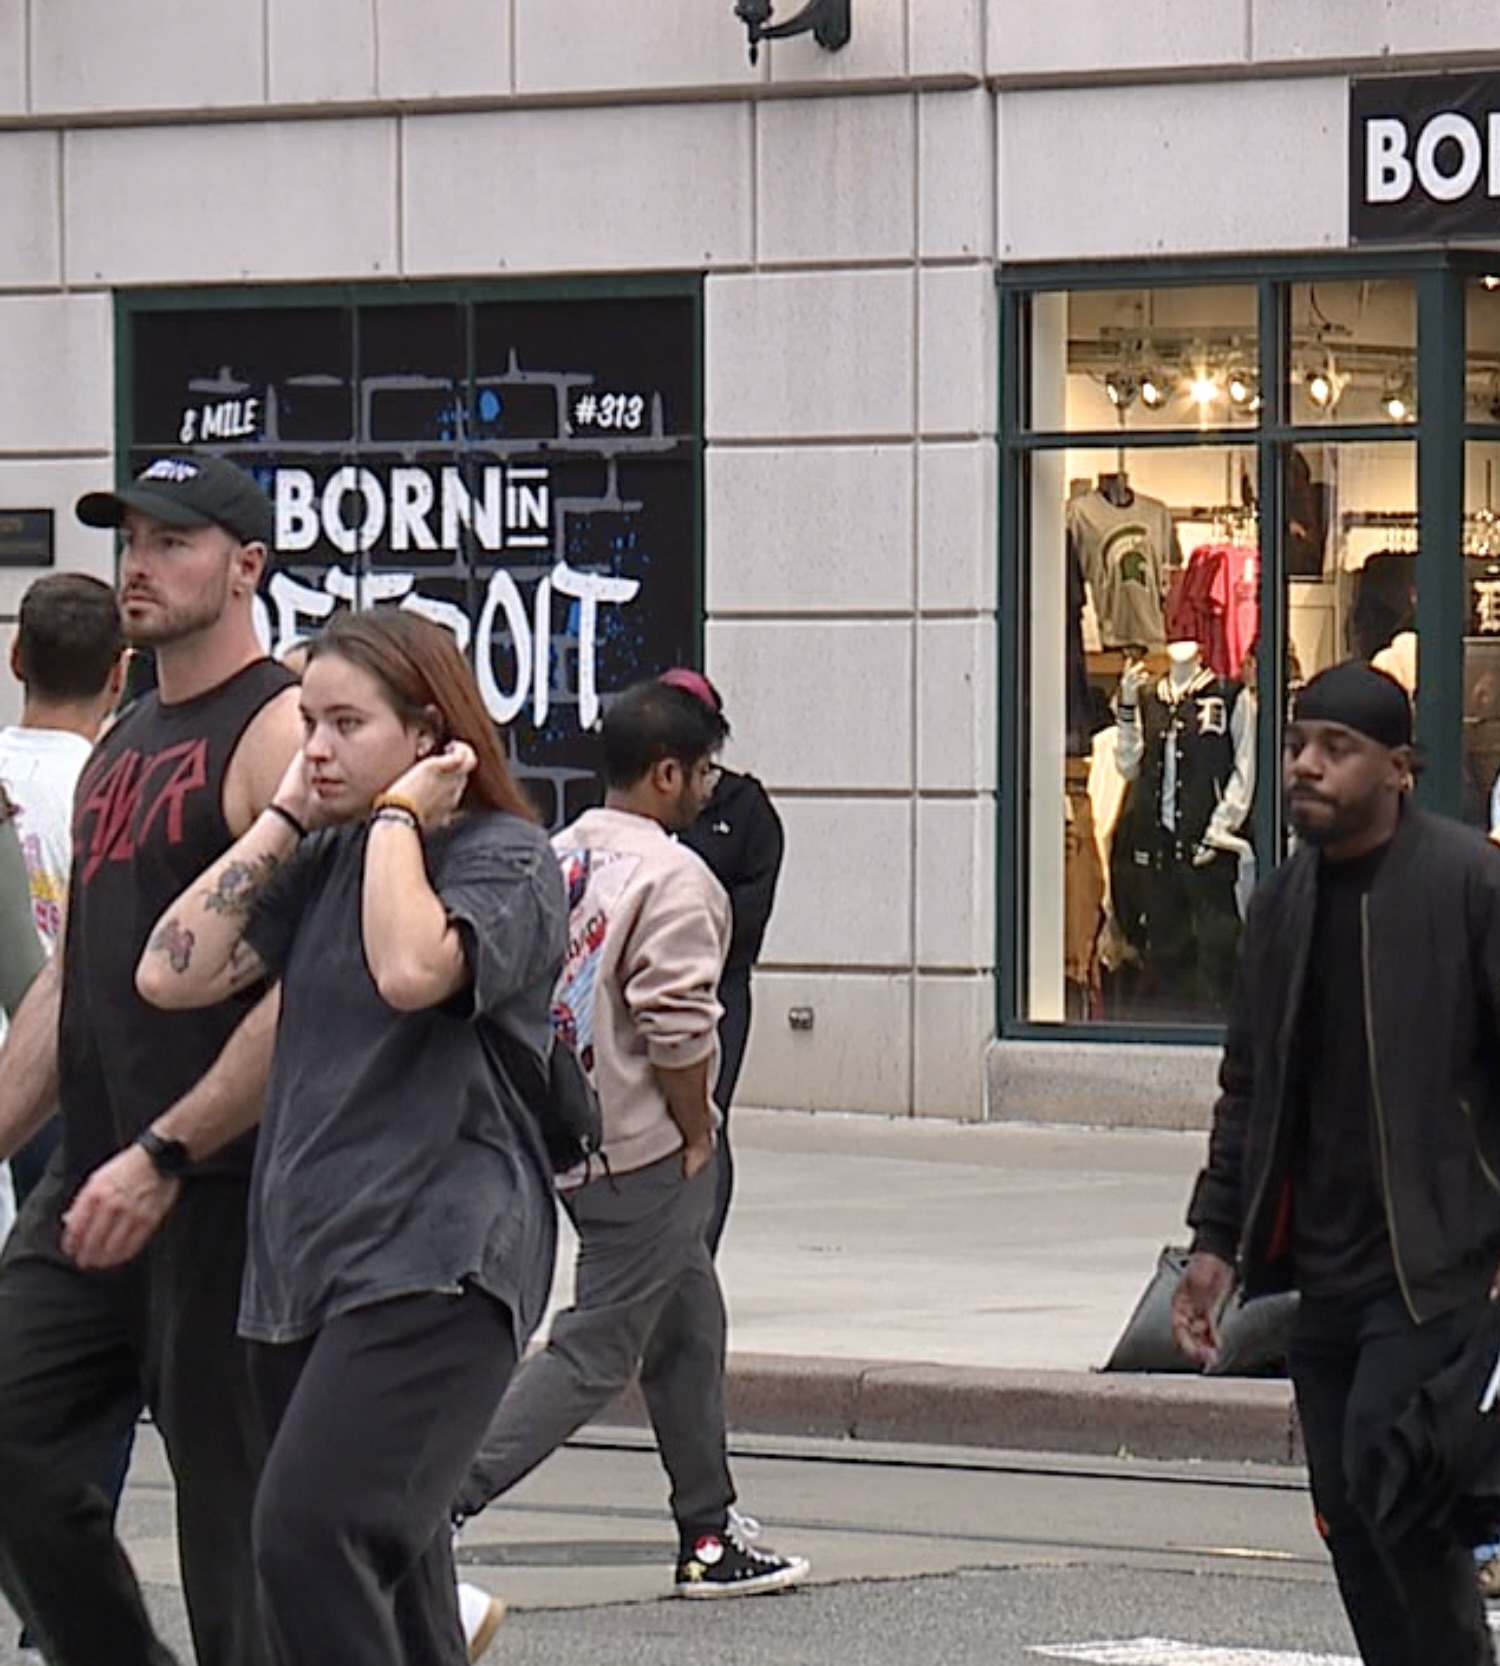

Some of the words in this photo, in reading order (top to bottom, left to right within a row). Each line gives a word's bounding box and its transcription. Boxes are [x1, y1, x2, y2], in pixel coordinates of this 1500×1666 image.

[201, 398, 258, 440] MILE
[575, 393, 643, 429] #313
[275, 466, 501, 554] BORN
[507, 485, 548, 529] IN
